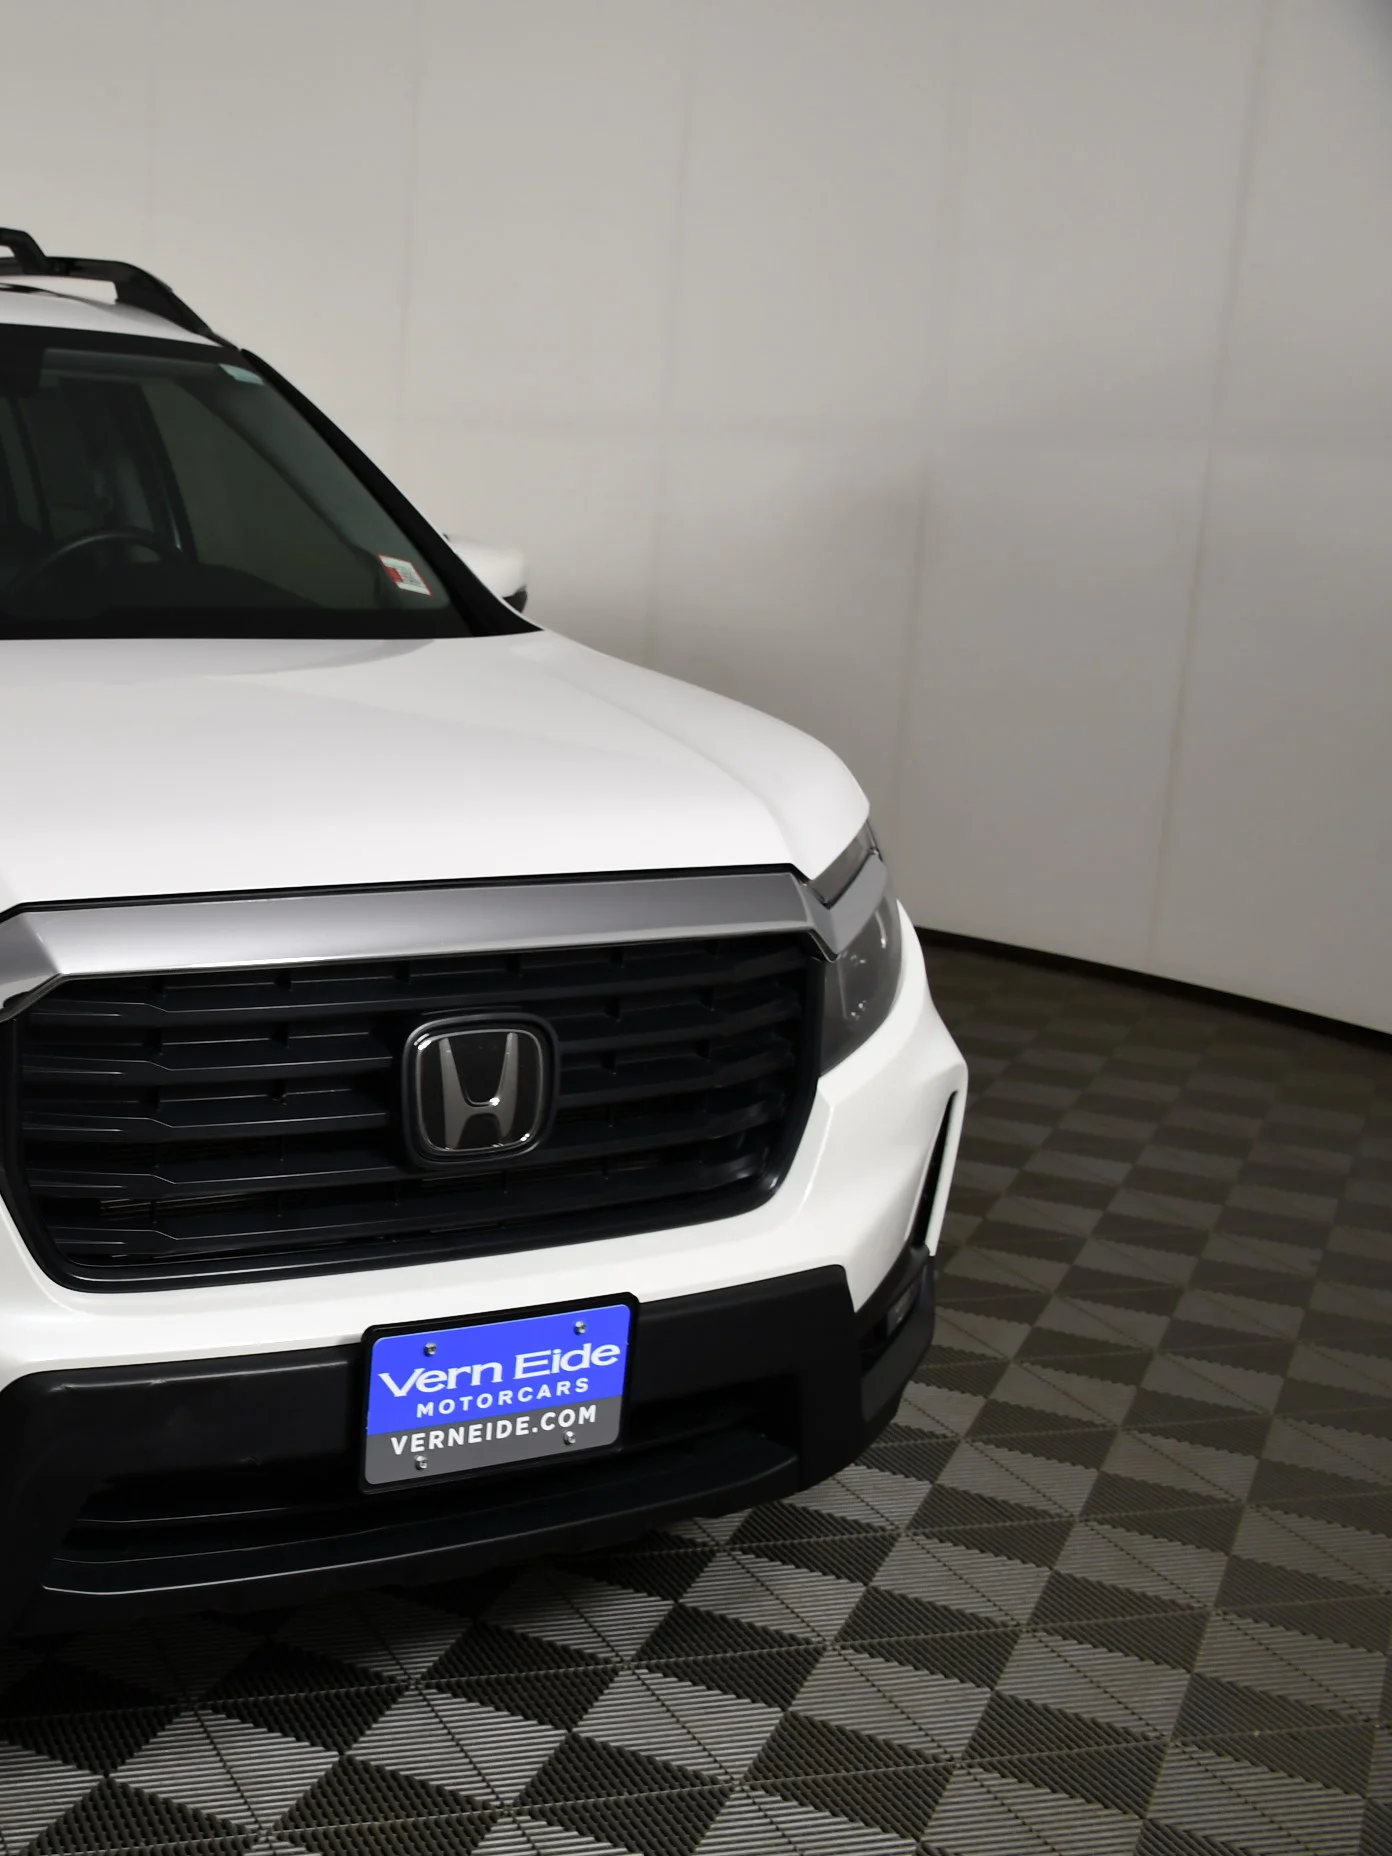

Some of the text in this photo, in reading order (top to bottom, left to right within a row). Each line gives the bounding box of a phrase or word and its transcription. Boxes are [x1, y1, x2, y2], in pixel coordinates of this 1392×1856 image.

[377, 1342, 621, 1398] Vern Eide
[416, 1377, 589, 1418] MOTORCARS
[390, 1404, 597, 1456] VERNEIDE.COM
